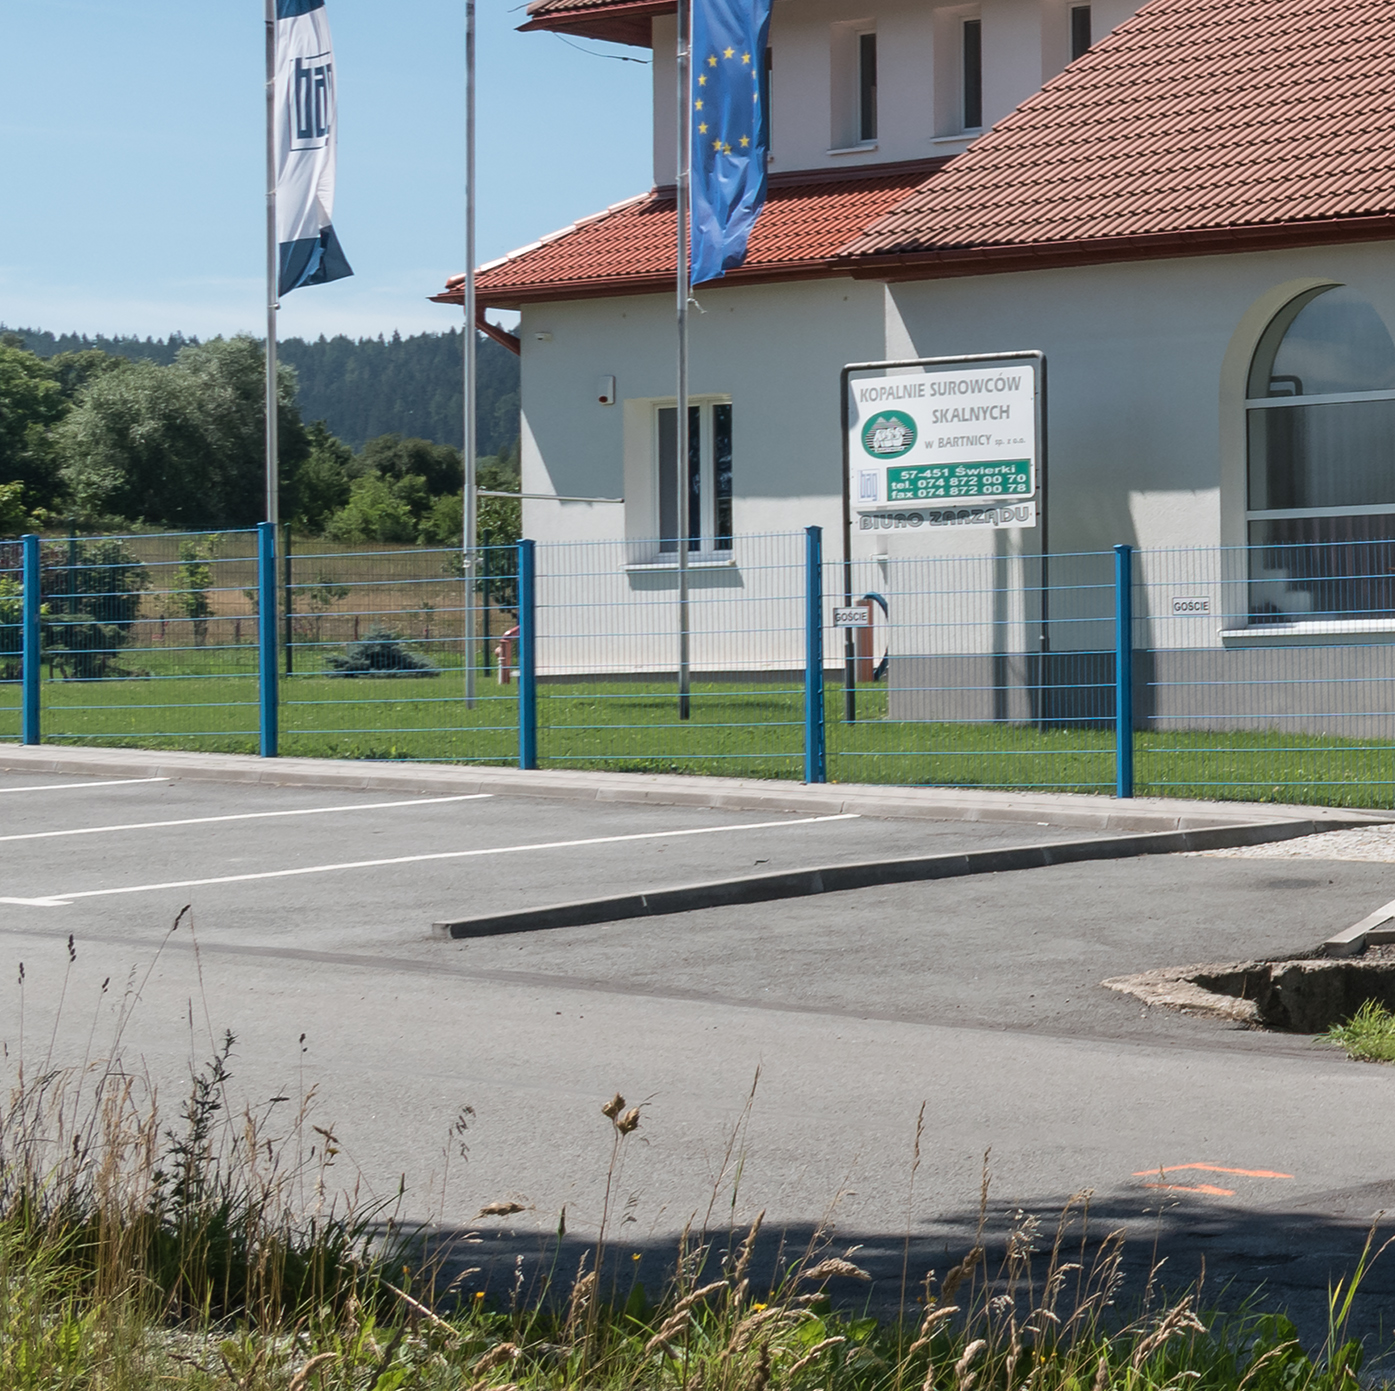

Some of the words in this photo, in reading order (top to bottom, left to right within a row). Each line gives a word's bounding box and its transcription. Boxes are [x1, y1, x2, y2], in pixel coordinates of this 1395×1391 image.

[860, 383, 925, 403] KOPALNIE
[930, 373, 1021, 397] SUROWCÓW
[932, 405, 1010, 424] SKALNYCH
[938, 434, 992, 448] BARTNICY
[900, 468, 949, 479] 57-451
[955, 465, 1016, 476] Świerki
[891, 480, 913, 489] tel.
[918, 478, 945, 488] 074
[950, 476, 977, 485] 872
[983, 475, 1002, 484] 00
[1008, 474, 1026, 483] 70
[891, 489, 913, 499] fax
[918, 488, 945, 497] 074
[950, 486, 977, 495] 872
[983, 485, 1002, 494] 00
[1008, 484, 1026, 492] 78
[860, 513, 924, 530] BIURO
[929, 507, 1029, 526] ZARZĄDU
[1174, 600, 1209, 611] GOŚCIE
